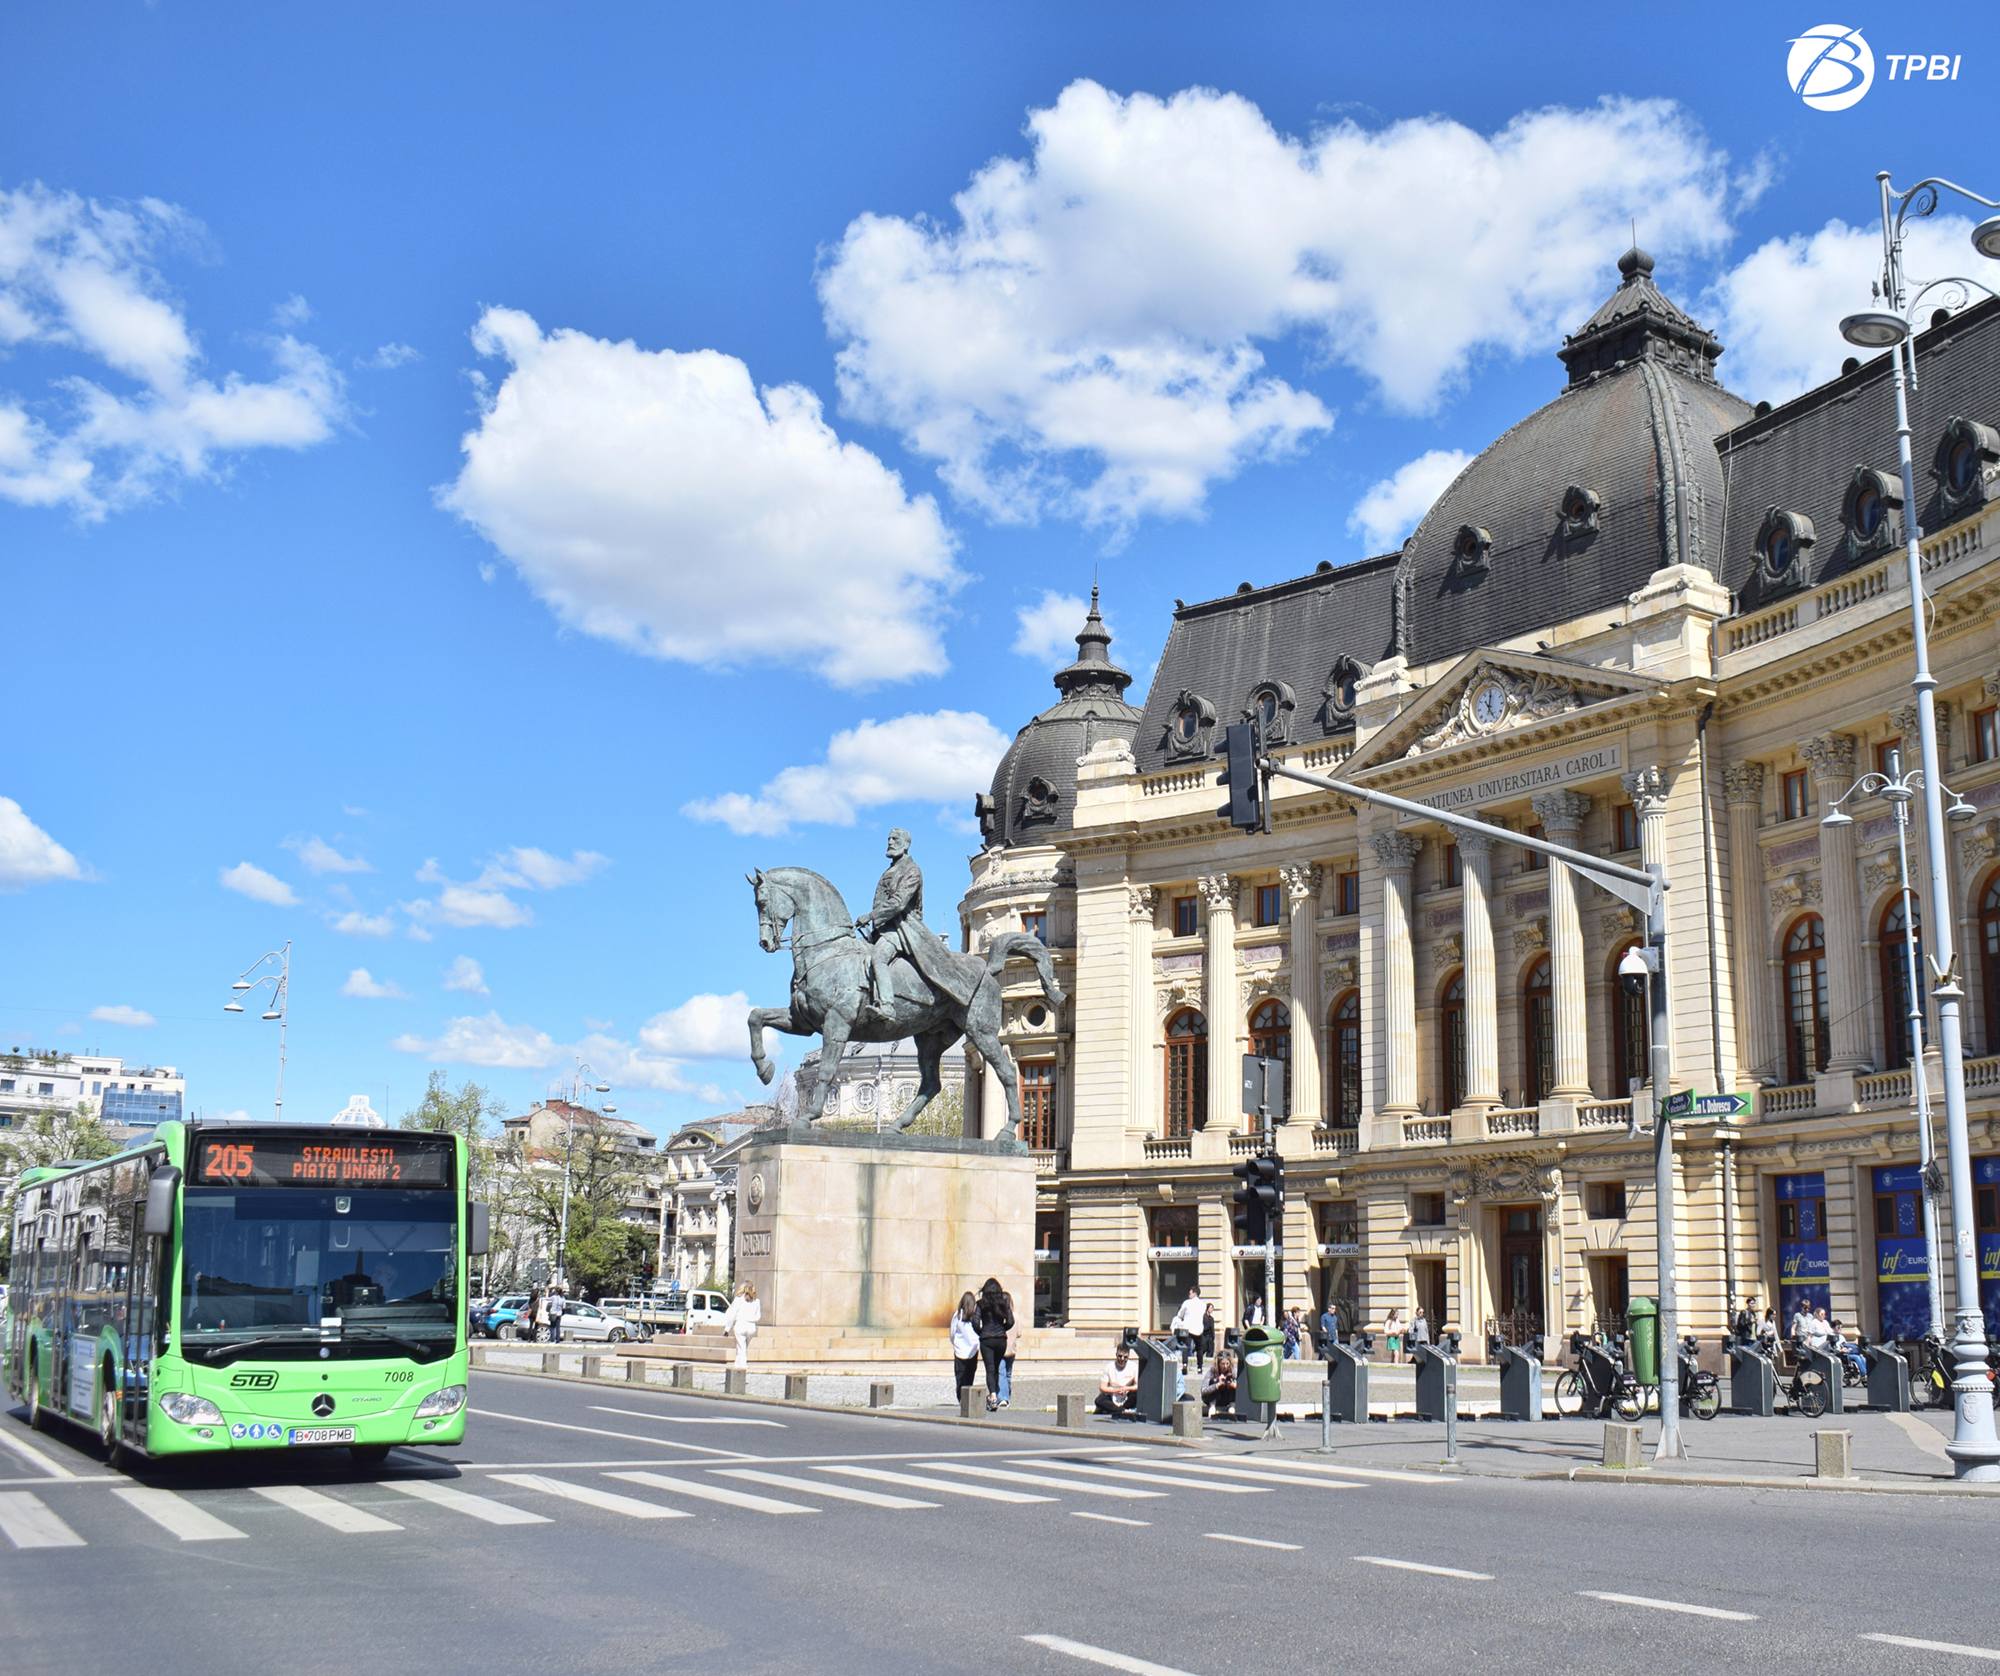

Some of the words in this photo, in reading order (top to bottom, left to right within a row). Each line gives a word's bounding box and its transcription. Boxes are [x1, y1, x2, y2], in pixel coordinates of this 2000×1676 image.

[1478, 764, 1560, 799] UNIVERSITARA
[1566, 752, 1607, 777] CAROL
[1611, 749, 1616, 765] I
[205, 1144, 254, 1177] 205
[302, 1147, 394, 1164] STRAULESTI
[292, 1163, 337, 1179] PIATA
[391, 1165, 401, 1180] 2
[230, 1374, 275, 1387] STB
[384, 1371, 415, 1383] 7008
